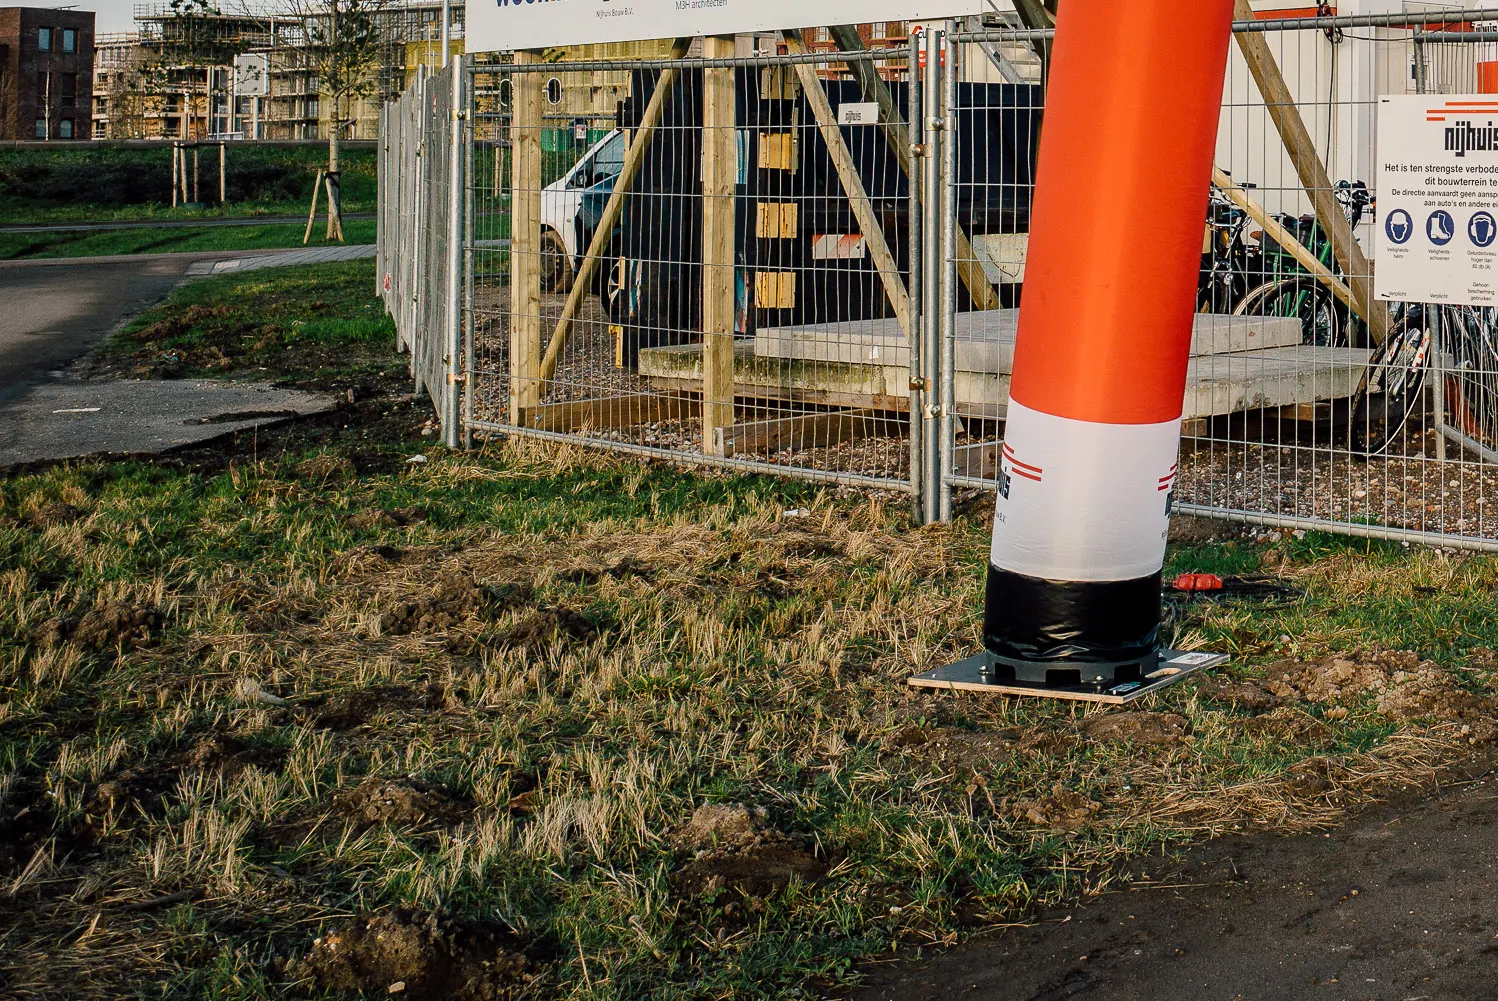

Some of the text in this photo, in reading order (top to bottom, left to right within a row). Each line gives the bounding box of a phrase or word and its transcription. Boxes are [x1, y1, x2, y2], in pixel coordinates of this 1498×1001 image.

[676, 0, 690, 10] M3H
[1384, 164, 1399, 172] Het
[1410, 164, 1422, 172] ten
[1425, 165, 1463, 174] strengste
[1425, 177, 1436, 186] dit
[1437, 177, 1487, 186] bouwterrein
[1489, 178, 1497, 187] te
[1460, 191, 1476, 199] geen
